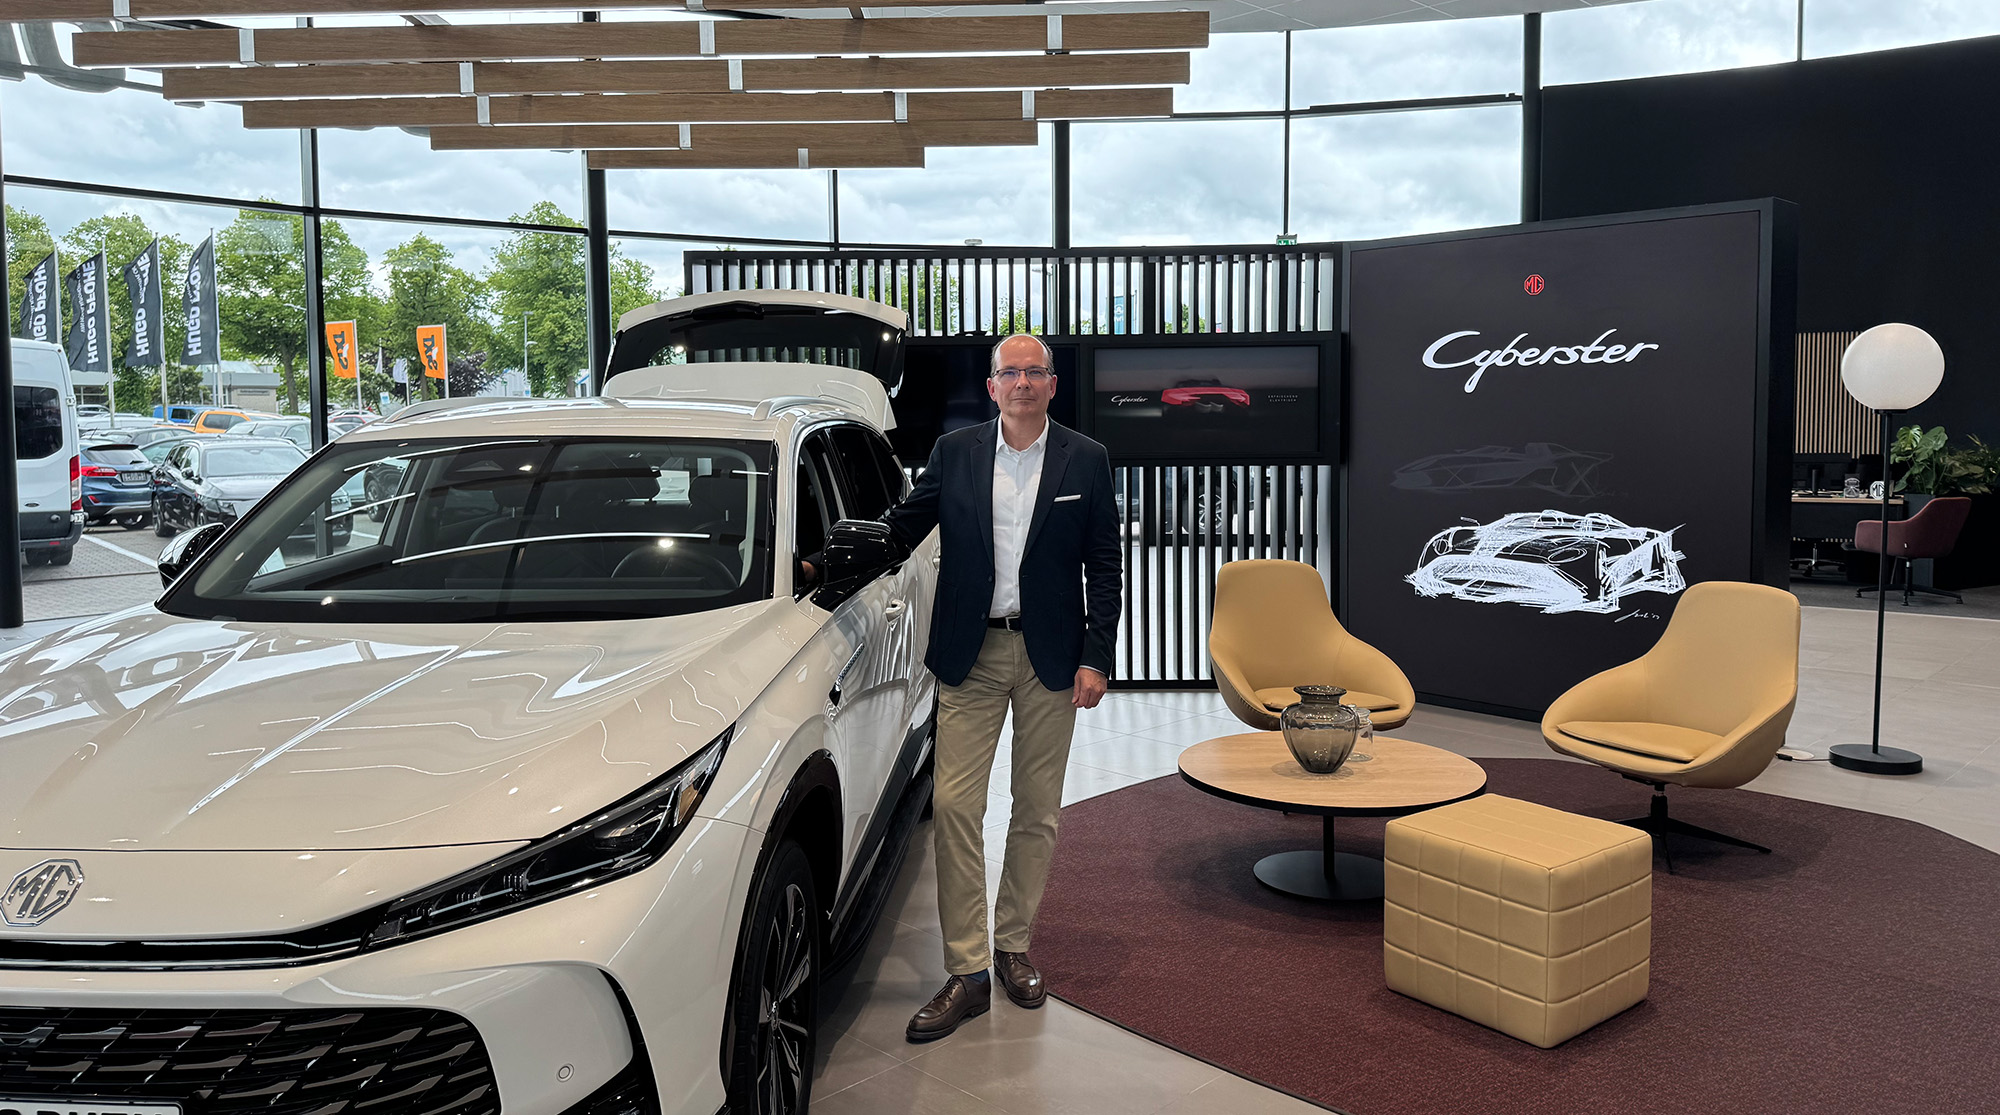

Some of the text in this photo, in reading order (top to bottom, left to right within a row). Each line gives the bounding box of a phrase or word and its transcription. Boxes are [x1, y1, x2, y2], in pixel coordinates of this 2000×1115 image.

[1526, 276, 1543, 293] MG
[1422, 328, 1660, 394] Cyberster
[1111, 394, 1148, 406] Cyberster
[5, 865, 76, 918] MG
